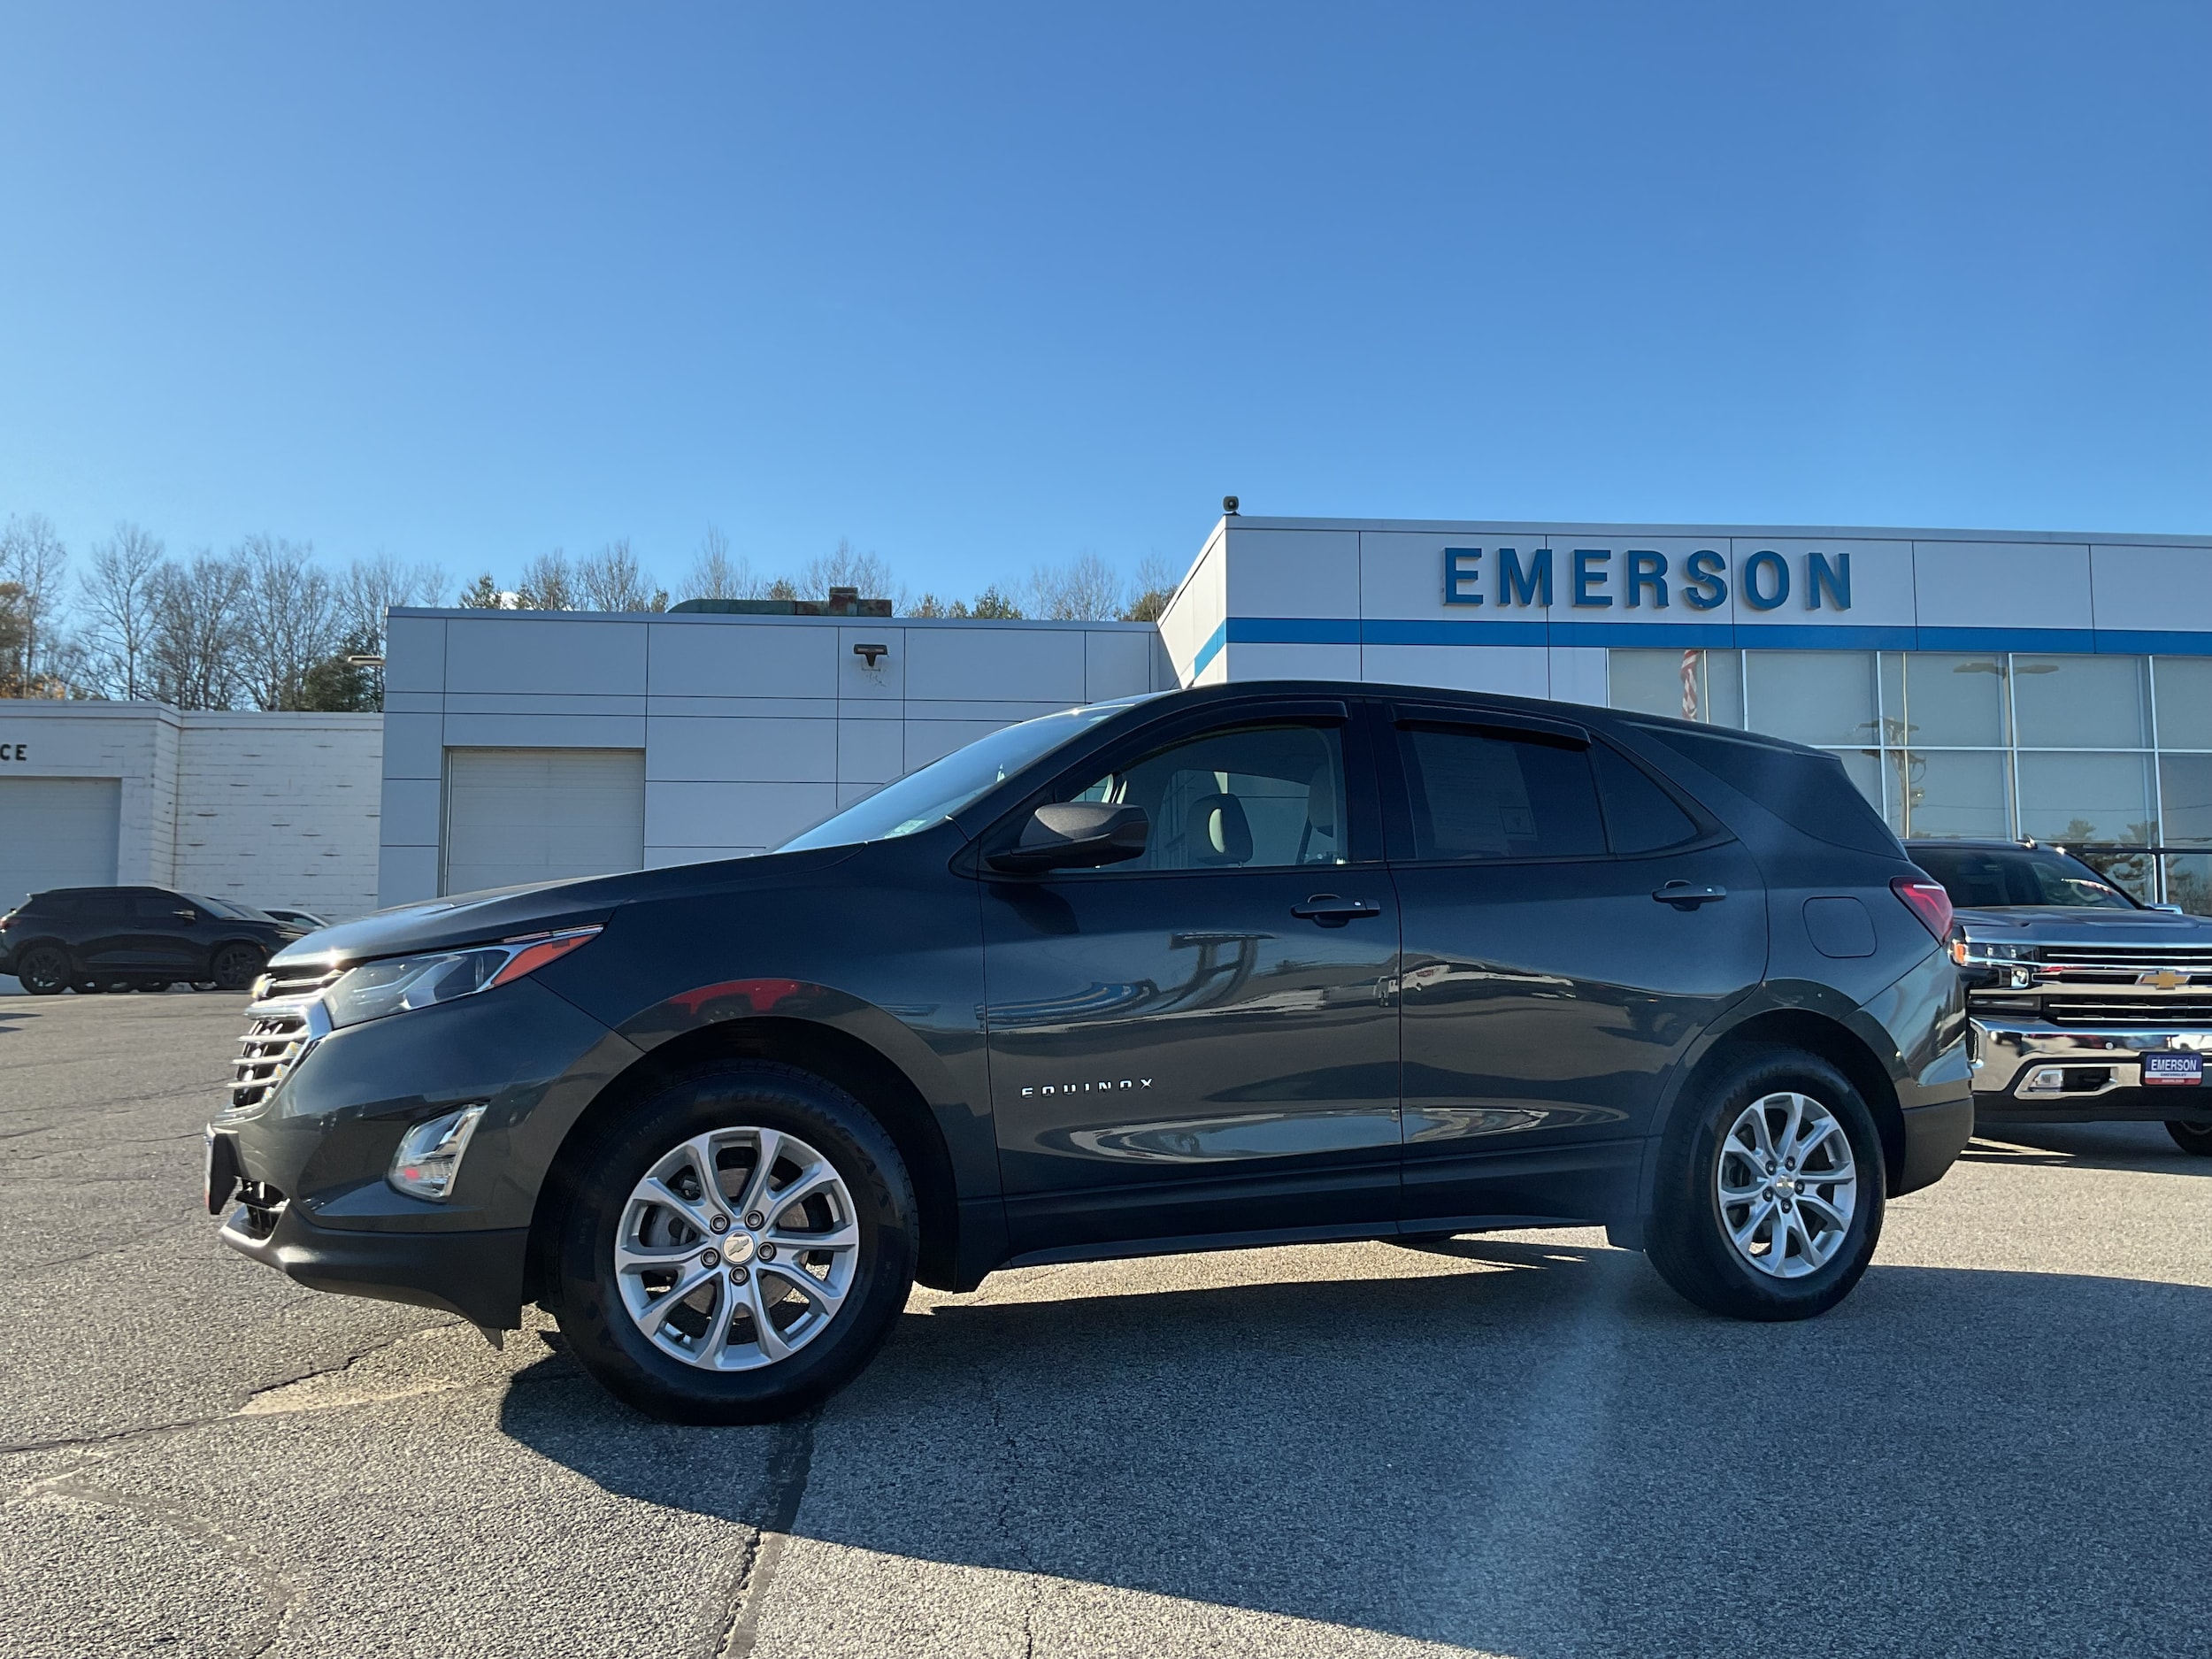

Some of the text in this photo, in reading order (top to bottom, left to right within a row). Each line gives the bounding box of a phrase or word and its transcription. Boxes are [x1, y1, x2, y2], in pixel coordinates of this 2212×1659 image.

[1443, 547, 1851, 610] EMERSON
[2151, 1058, 2197, 1071] EMERSON
[1021, 1078, 1154, 1098] EQUINOX
